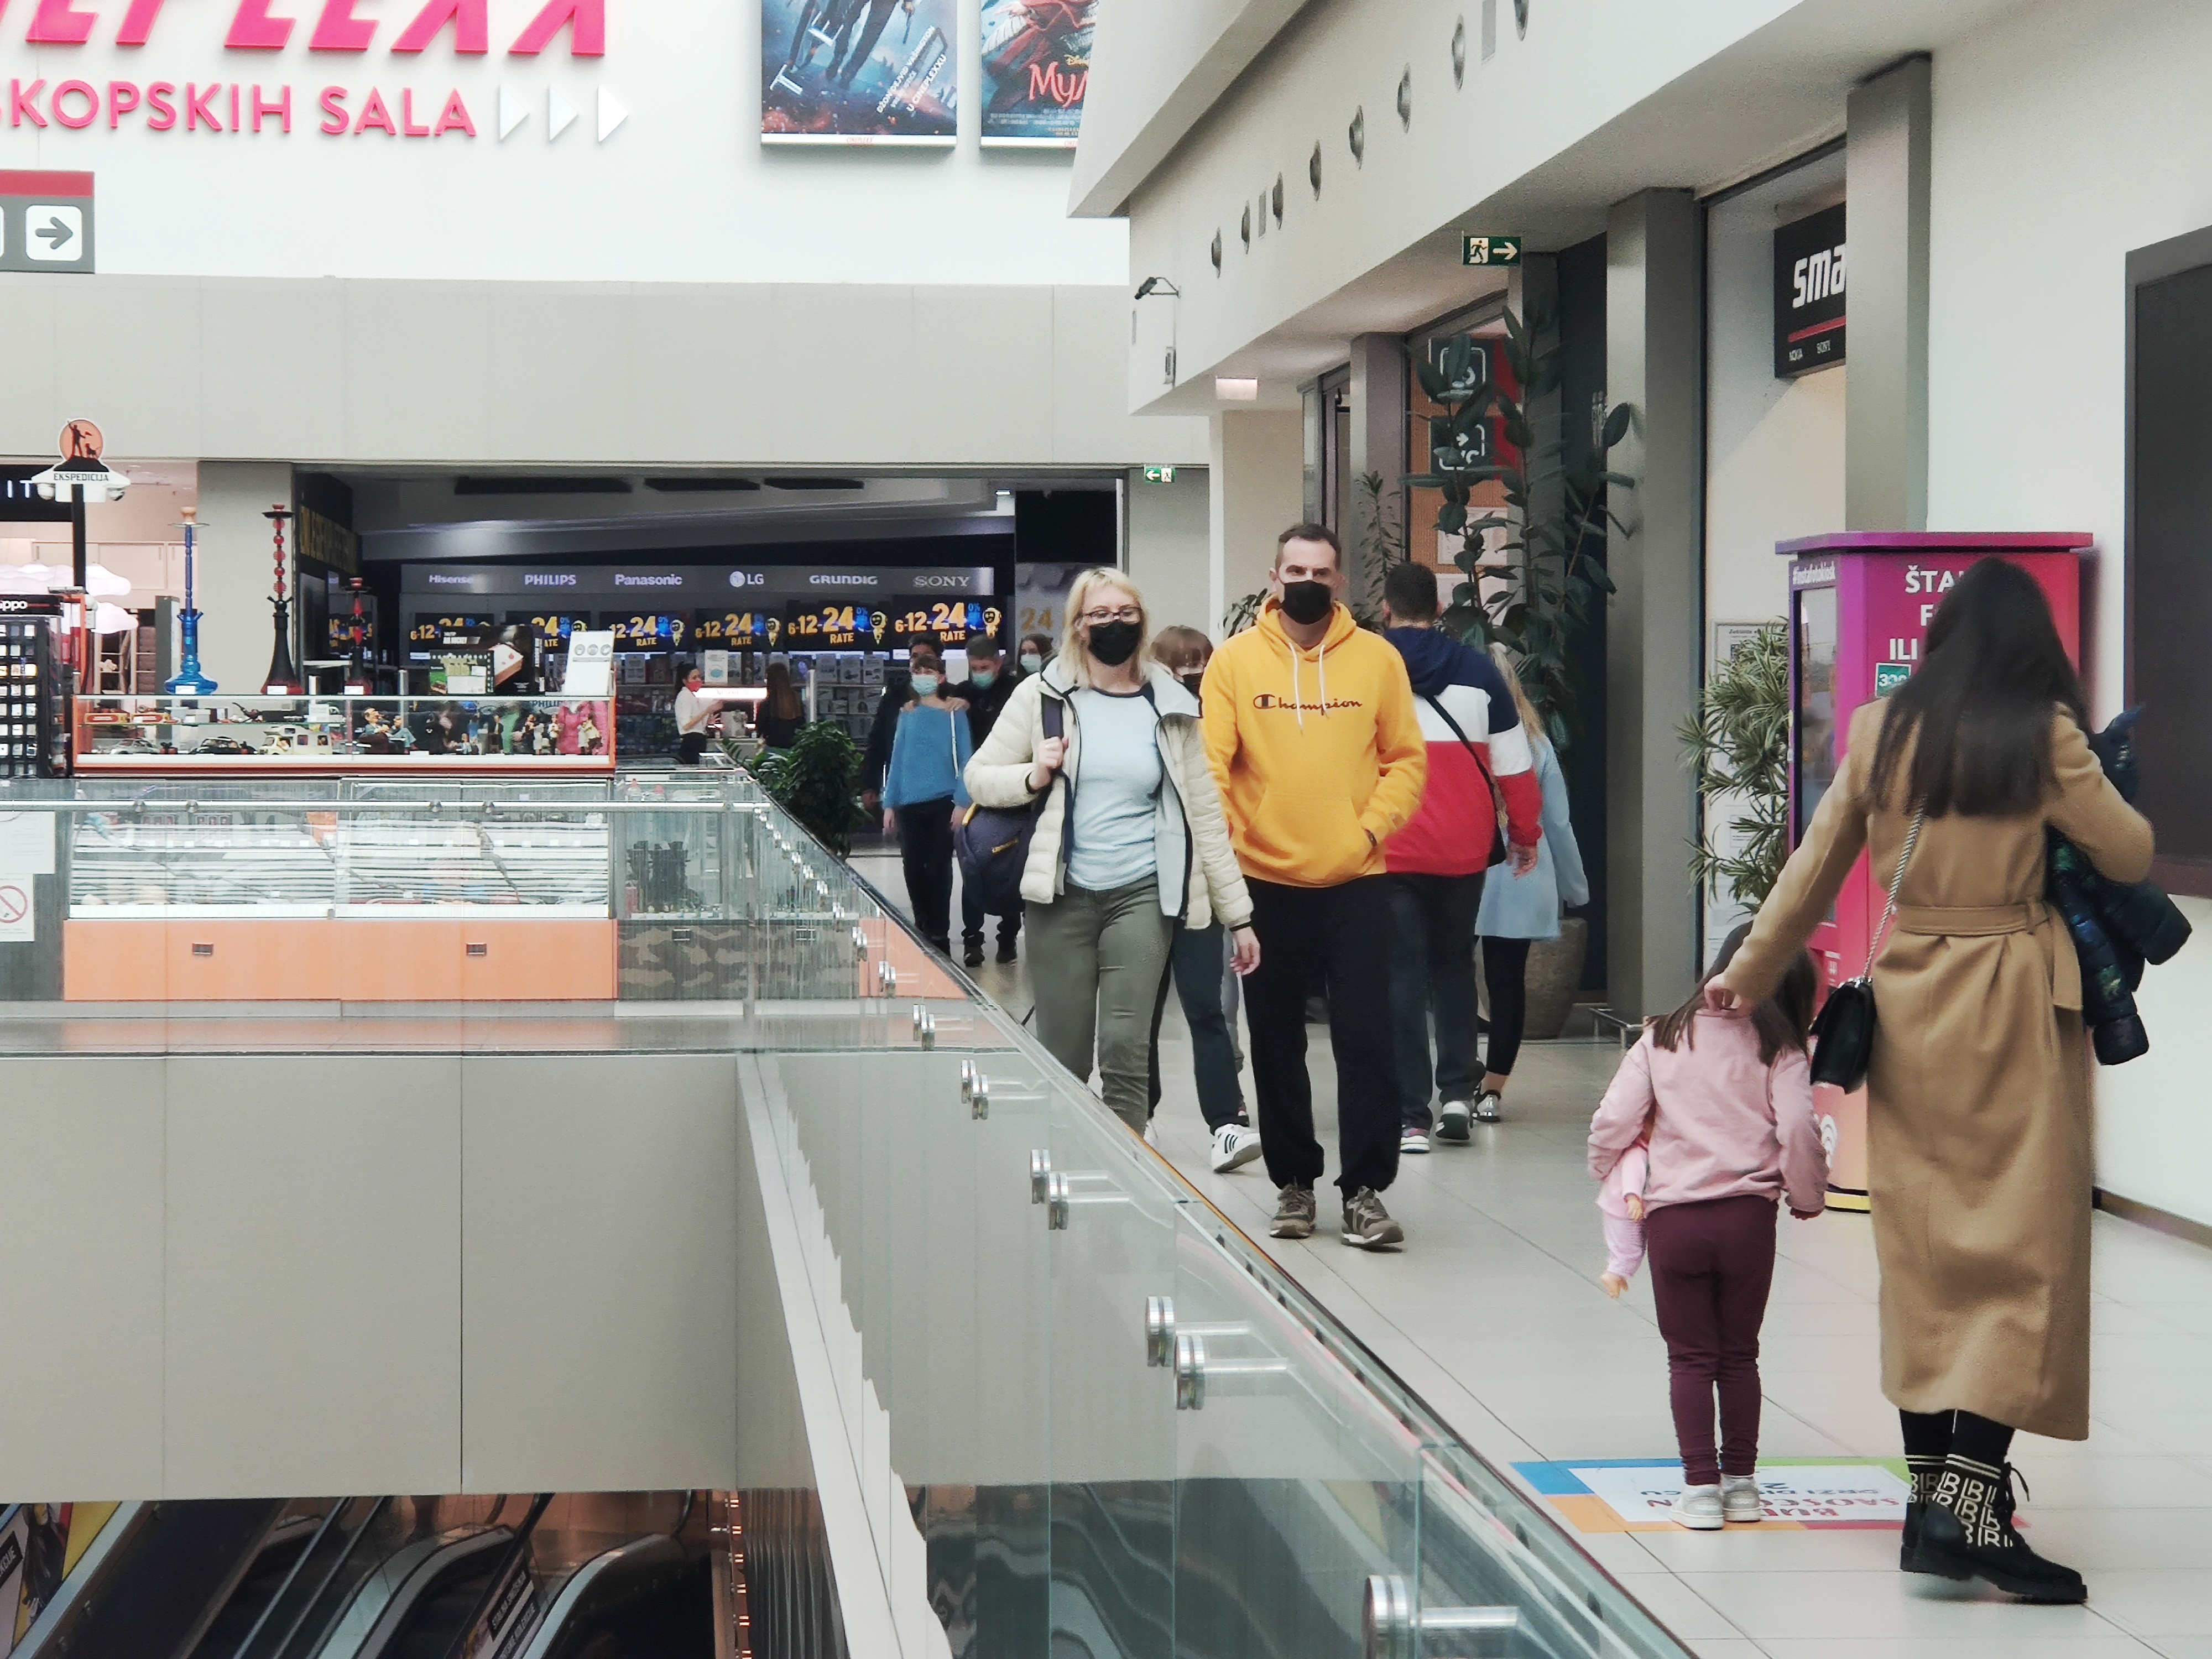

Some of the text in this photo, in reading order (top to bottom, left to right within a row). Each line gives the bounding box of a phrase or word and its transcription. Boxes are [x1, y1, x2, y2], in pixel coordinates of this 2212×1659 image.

[0, 78, 477, 138] KOPSKIH SALA
[429, 575, 474, 584] Hisense
[524, 574, 577, 586] PHILIPS
[614, 573, 683, 586] Panasonic
[747, 573, 764, 585] LG
[808, 575, 878, 585] GRUNDIG
[914, 576, 970, 587] SONY
[1905, 565, 1964, 593] ŠTA
[0, 600, 28, 612] ppo
[636, 637, 658, 648] RATE
[731, 636, 752, 647] RATE
[830, 632, 855, 645] RATE
[940, 630, 966, 643] RATE
[1889, 638, 1918, 660] ILI
[1253, 693, 1363, 716] Champion
